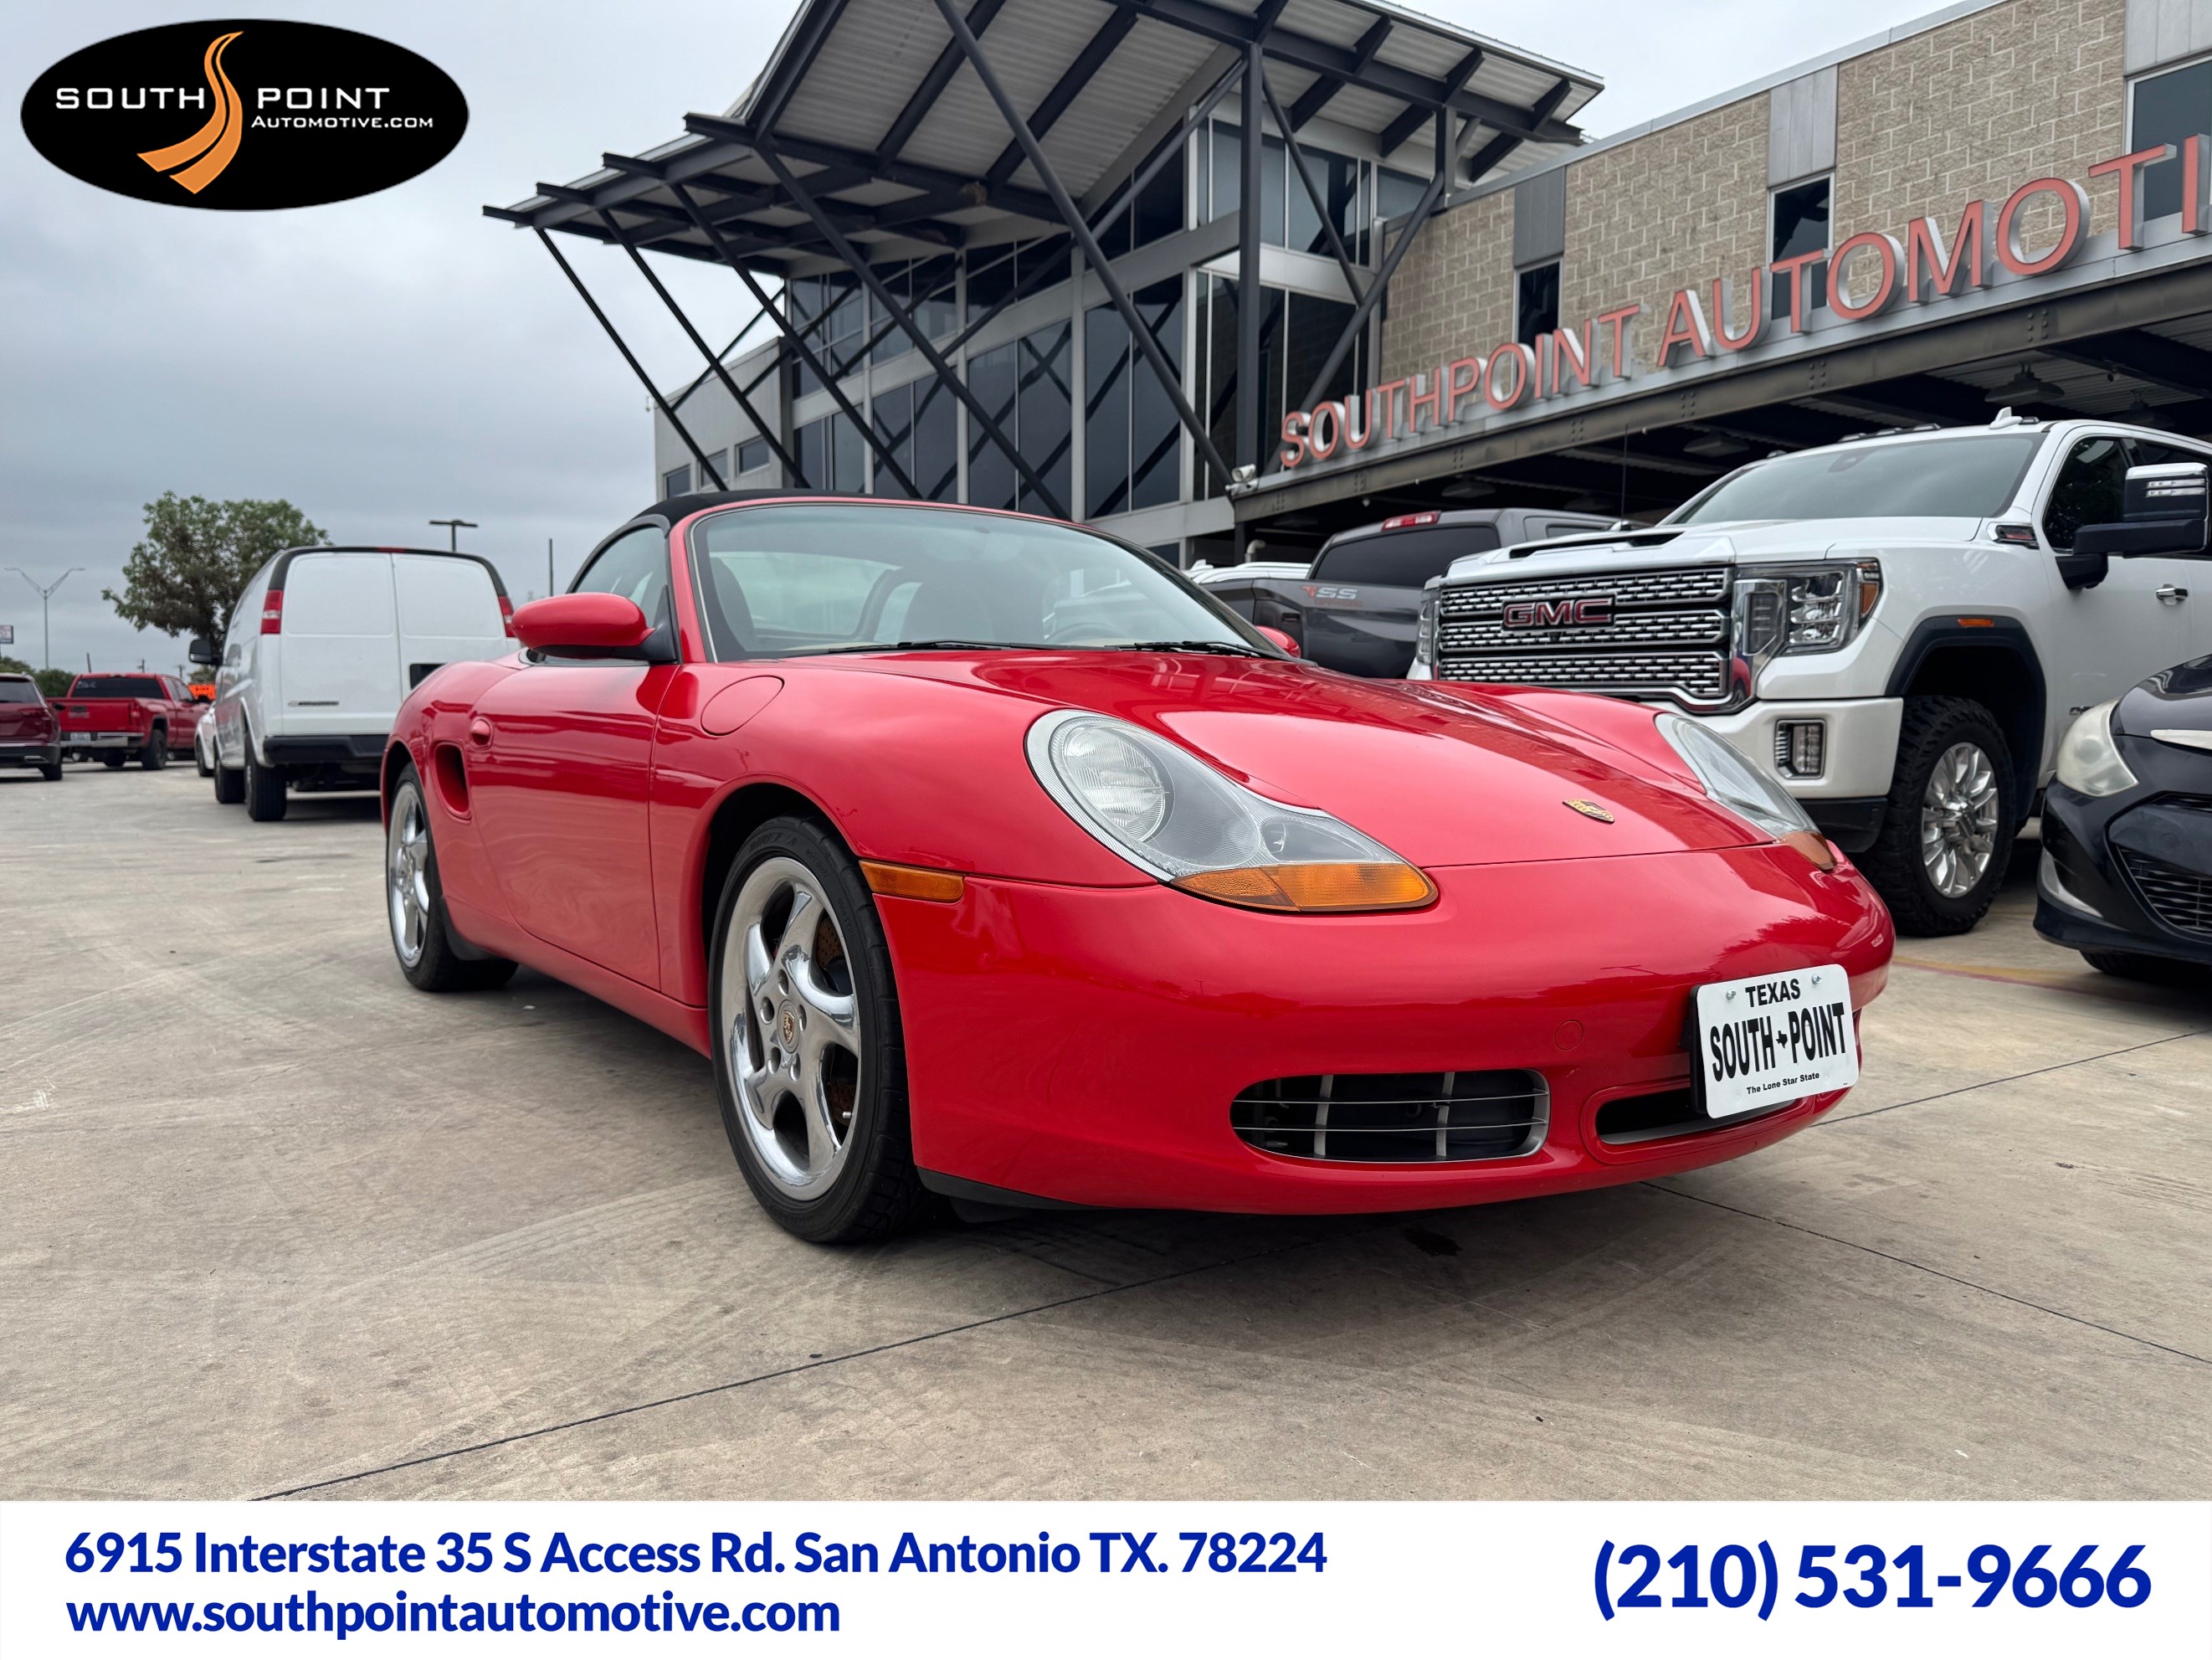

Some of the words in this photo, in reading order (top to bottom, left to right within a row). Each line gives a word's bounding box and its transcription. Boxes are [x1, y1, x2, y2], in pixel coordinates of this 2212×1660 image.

[1280, 306, 1642, 467] SOUTHPOINT
[1503, 597, 1614, 628] GMC
[1745, 978, 1801, 1008] TEXAS
[1710, 1015, 1776, 1082] SOUTH
[1788, 1001, 1846, 1064] POINT
[1746, 1086, 1761, 1095] The
[1763, 1080, 1781, 1092] Lone
[1782, 1077, 1799, 1087] Star
[1799, 1072, 1820, 1082] State
